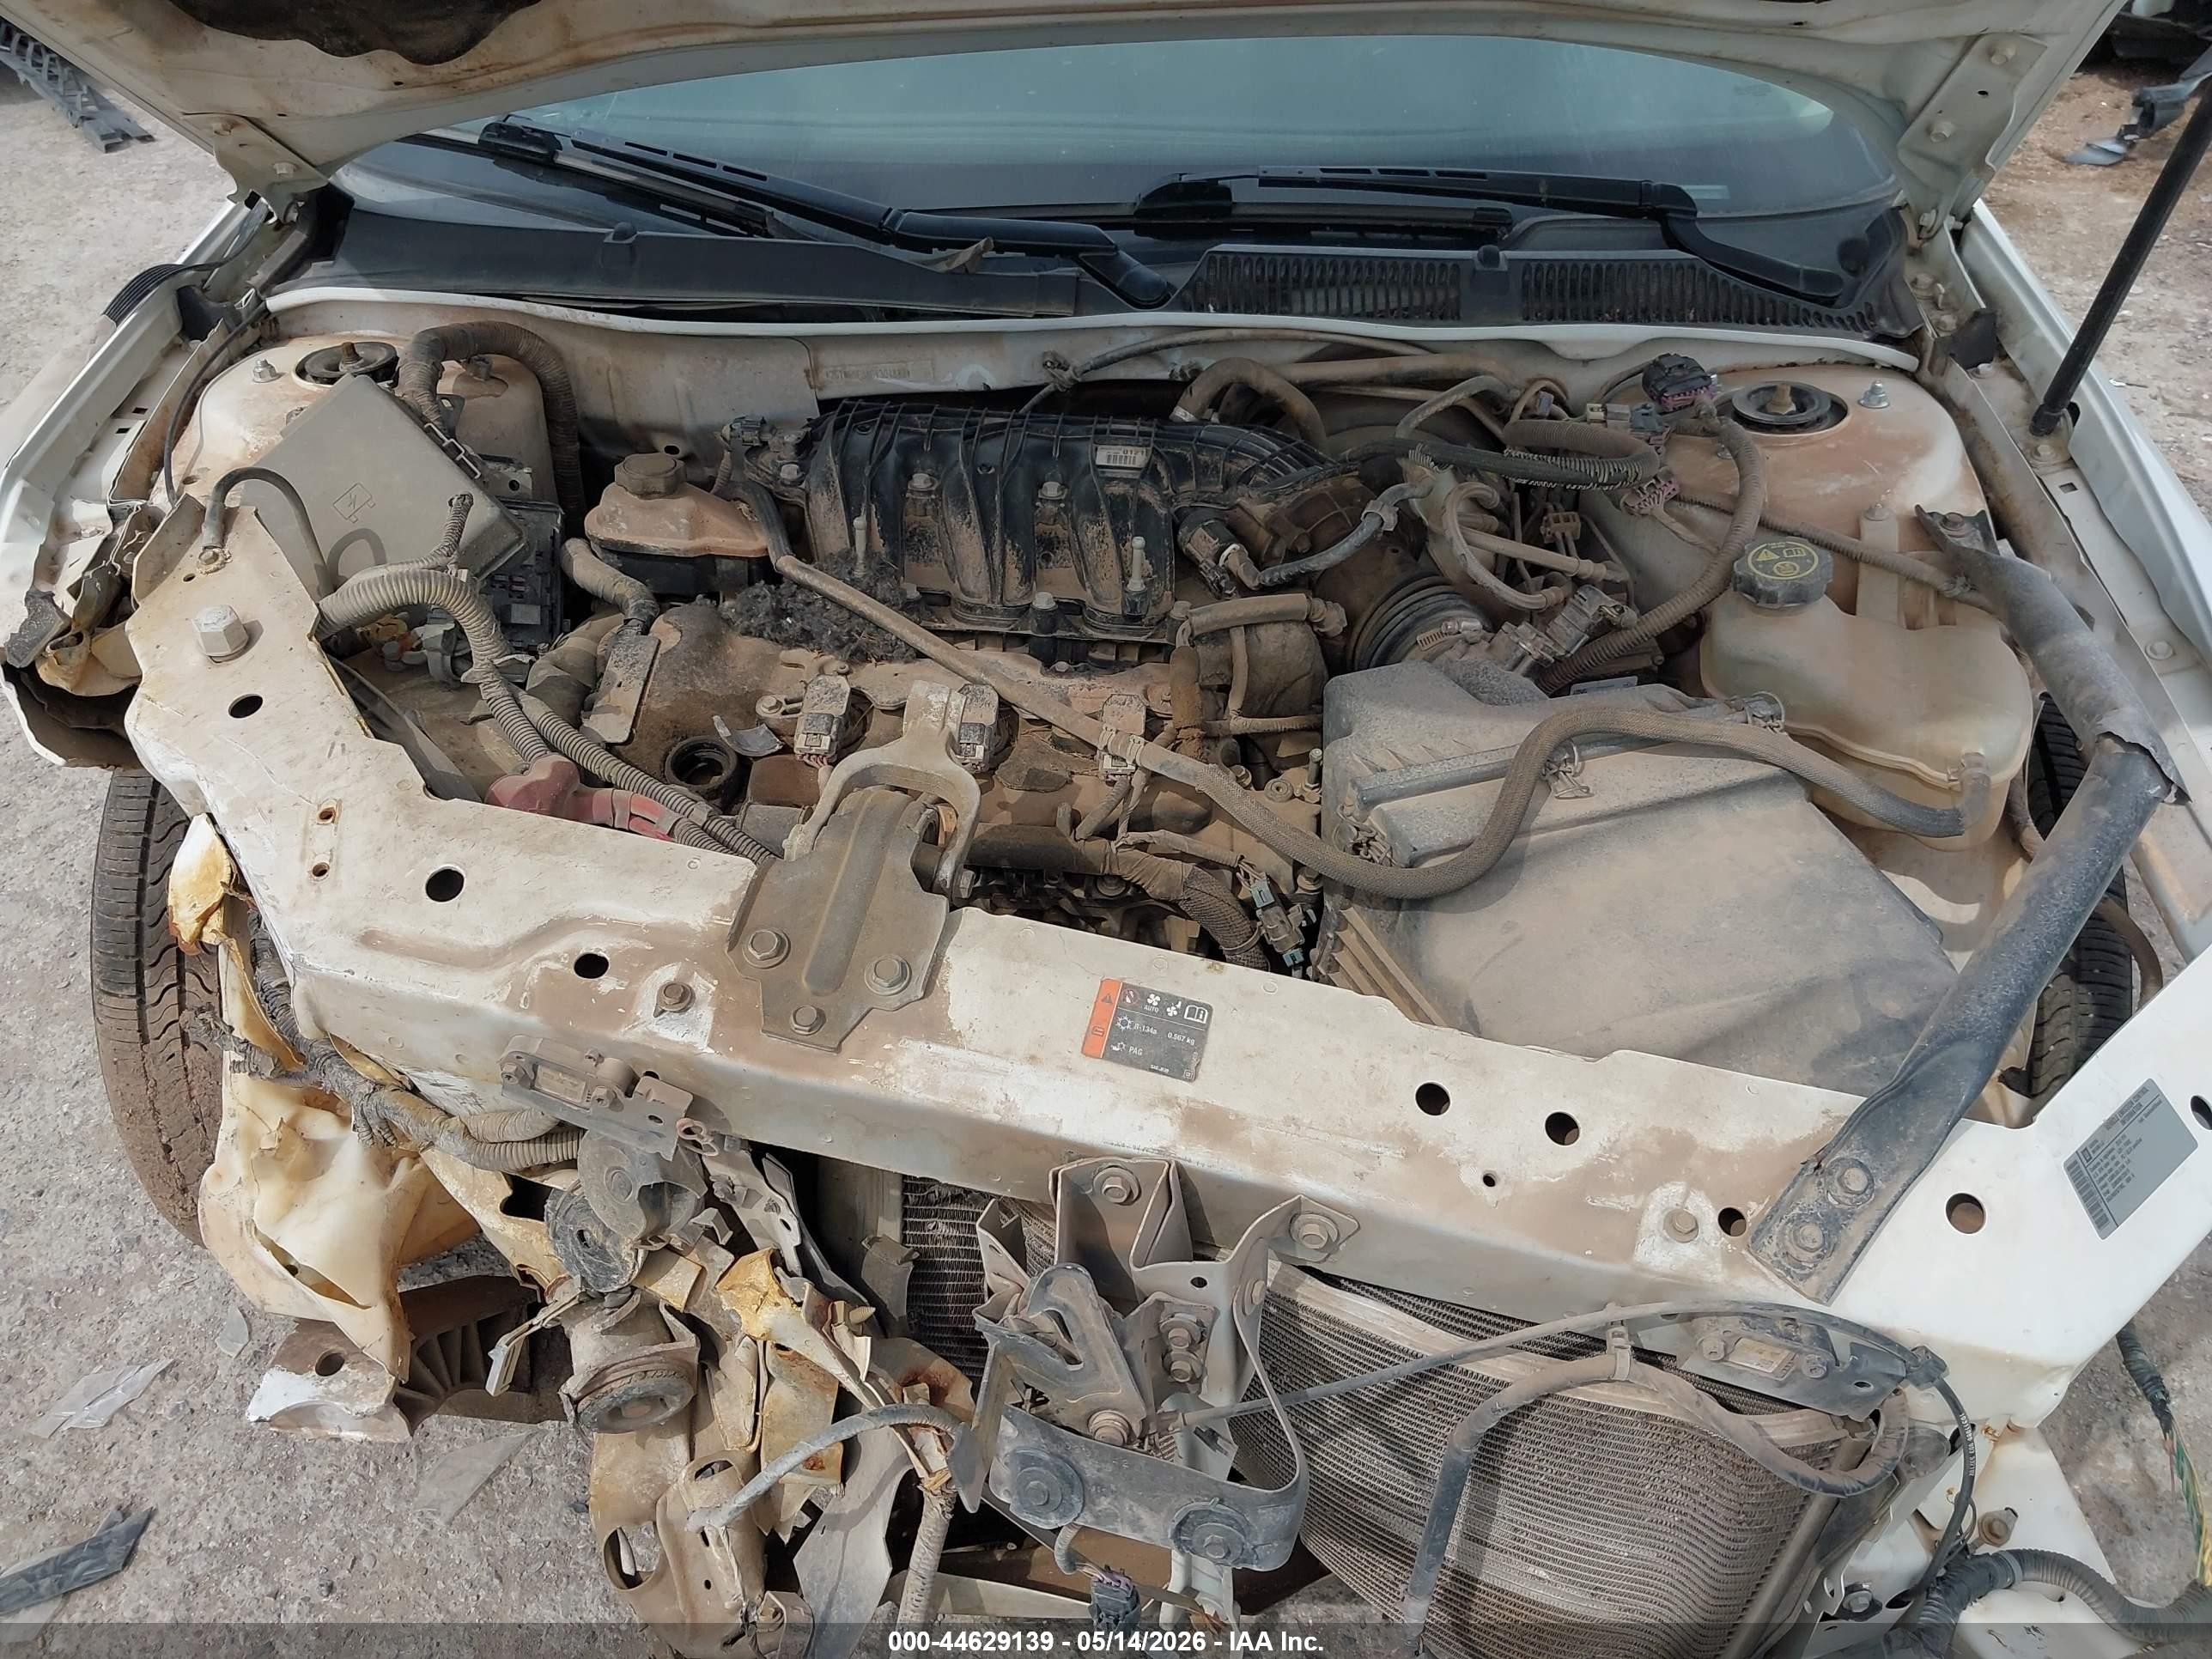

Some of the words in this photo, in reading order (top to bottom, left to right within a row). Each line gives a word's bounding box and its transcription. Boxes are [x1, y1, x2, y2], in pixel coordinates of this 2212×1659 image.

[1133, 1023, 1158, 1035] R-134a
[1167, 1032, 1186, 1042] 0.567
[1186, 1037, 1195, 1046] kg
[1128, 1046, 1144, 1056] PAG
